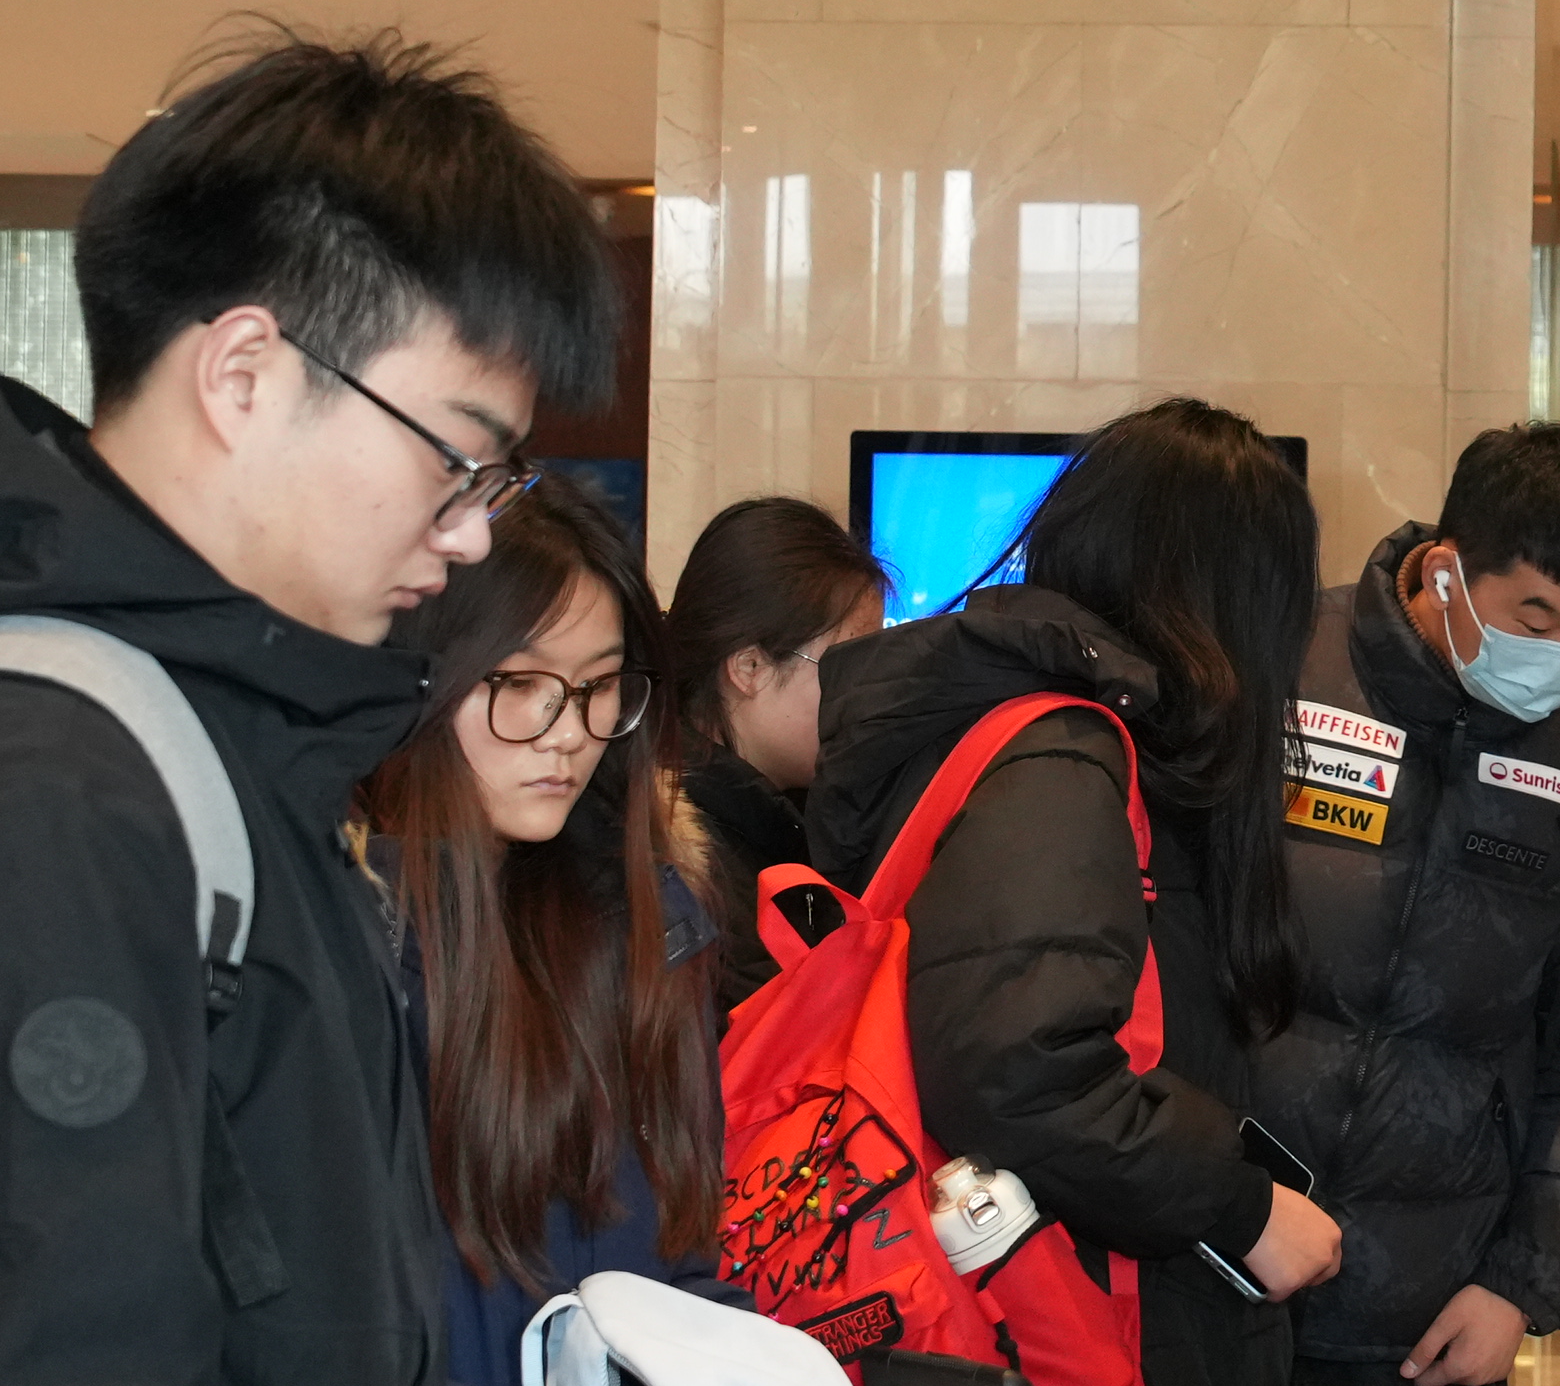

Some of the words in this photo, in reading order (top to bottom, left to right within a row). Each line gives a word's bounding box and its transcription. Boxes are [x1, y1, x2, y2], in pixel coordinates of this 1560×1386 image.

[1286, 707, 1400, 751] AIFFEISEN
[1312, 799, 1374, 832] BKW
[1465, 834, 1548, 870] DESCENTE
[808, 1301, 893, 1345] TRANGER
[826, 1325, 883, 1359] HINGS
